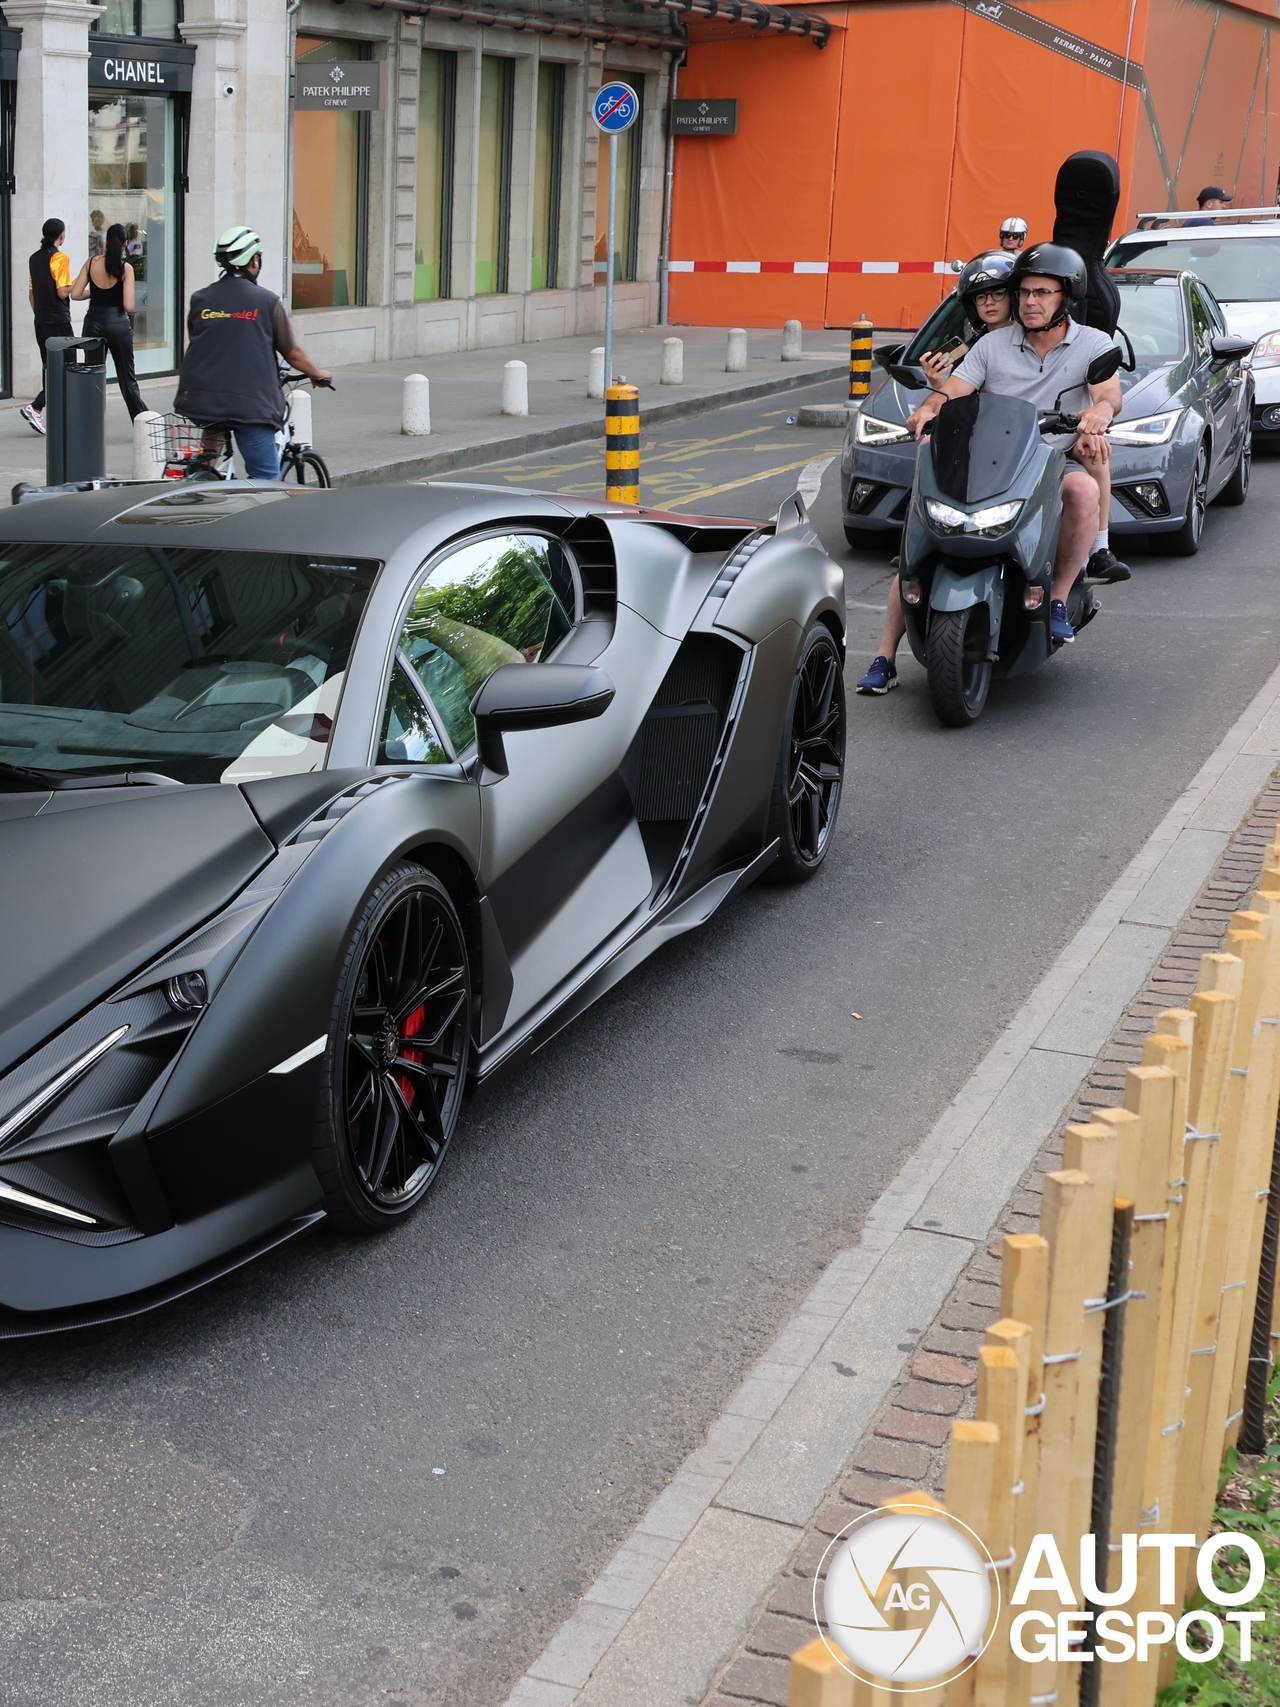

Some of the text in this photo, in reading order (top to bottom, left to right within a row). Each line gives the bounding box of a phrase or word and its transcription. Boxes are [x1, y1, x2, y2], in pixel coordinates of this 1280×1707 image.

[1089, 52, 1113, 68] PARIS
[104, 58, 165, 84] CHANEL
[302, 86, 371, 97] PATEK PHILIPPE
[676, 116, 729, 125] PATEK PHILIPPE
